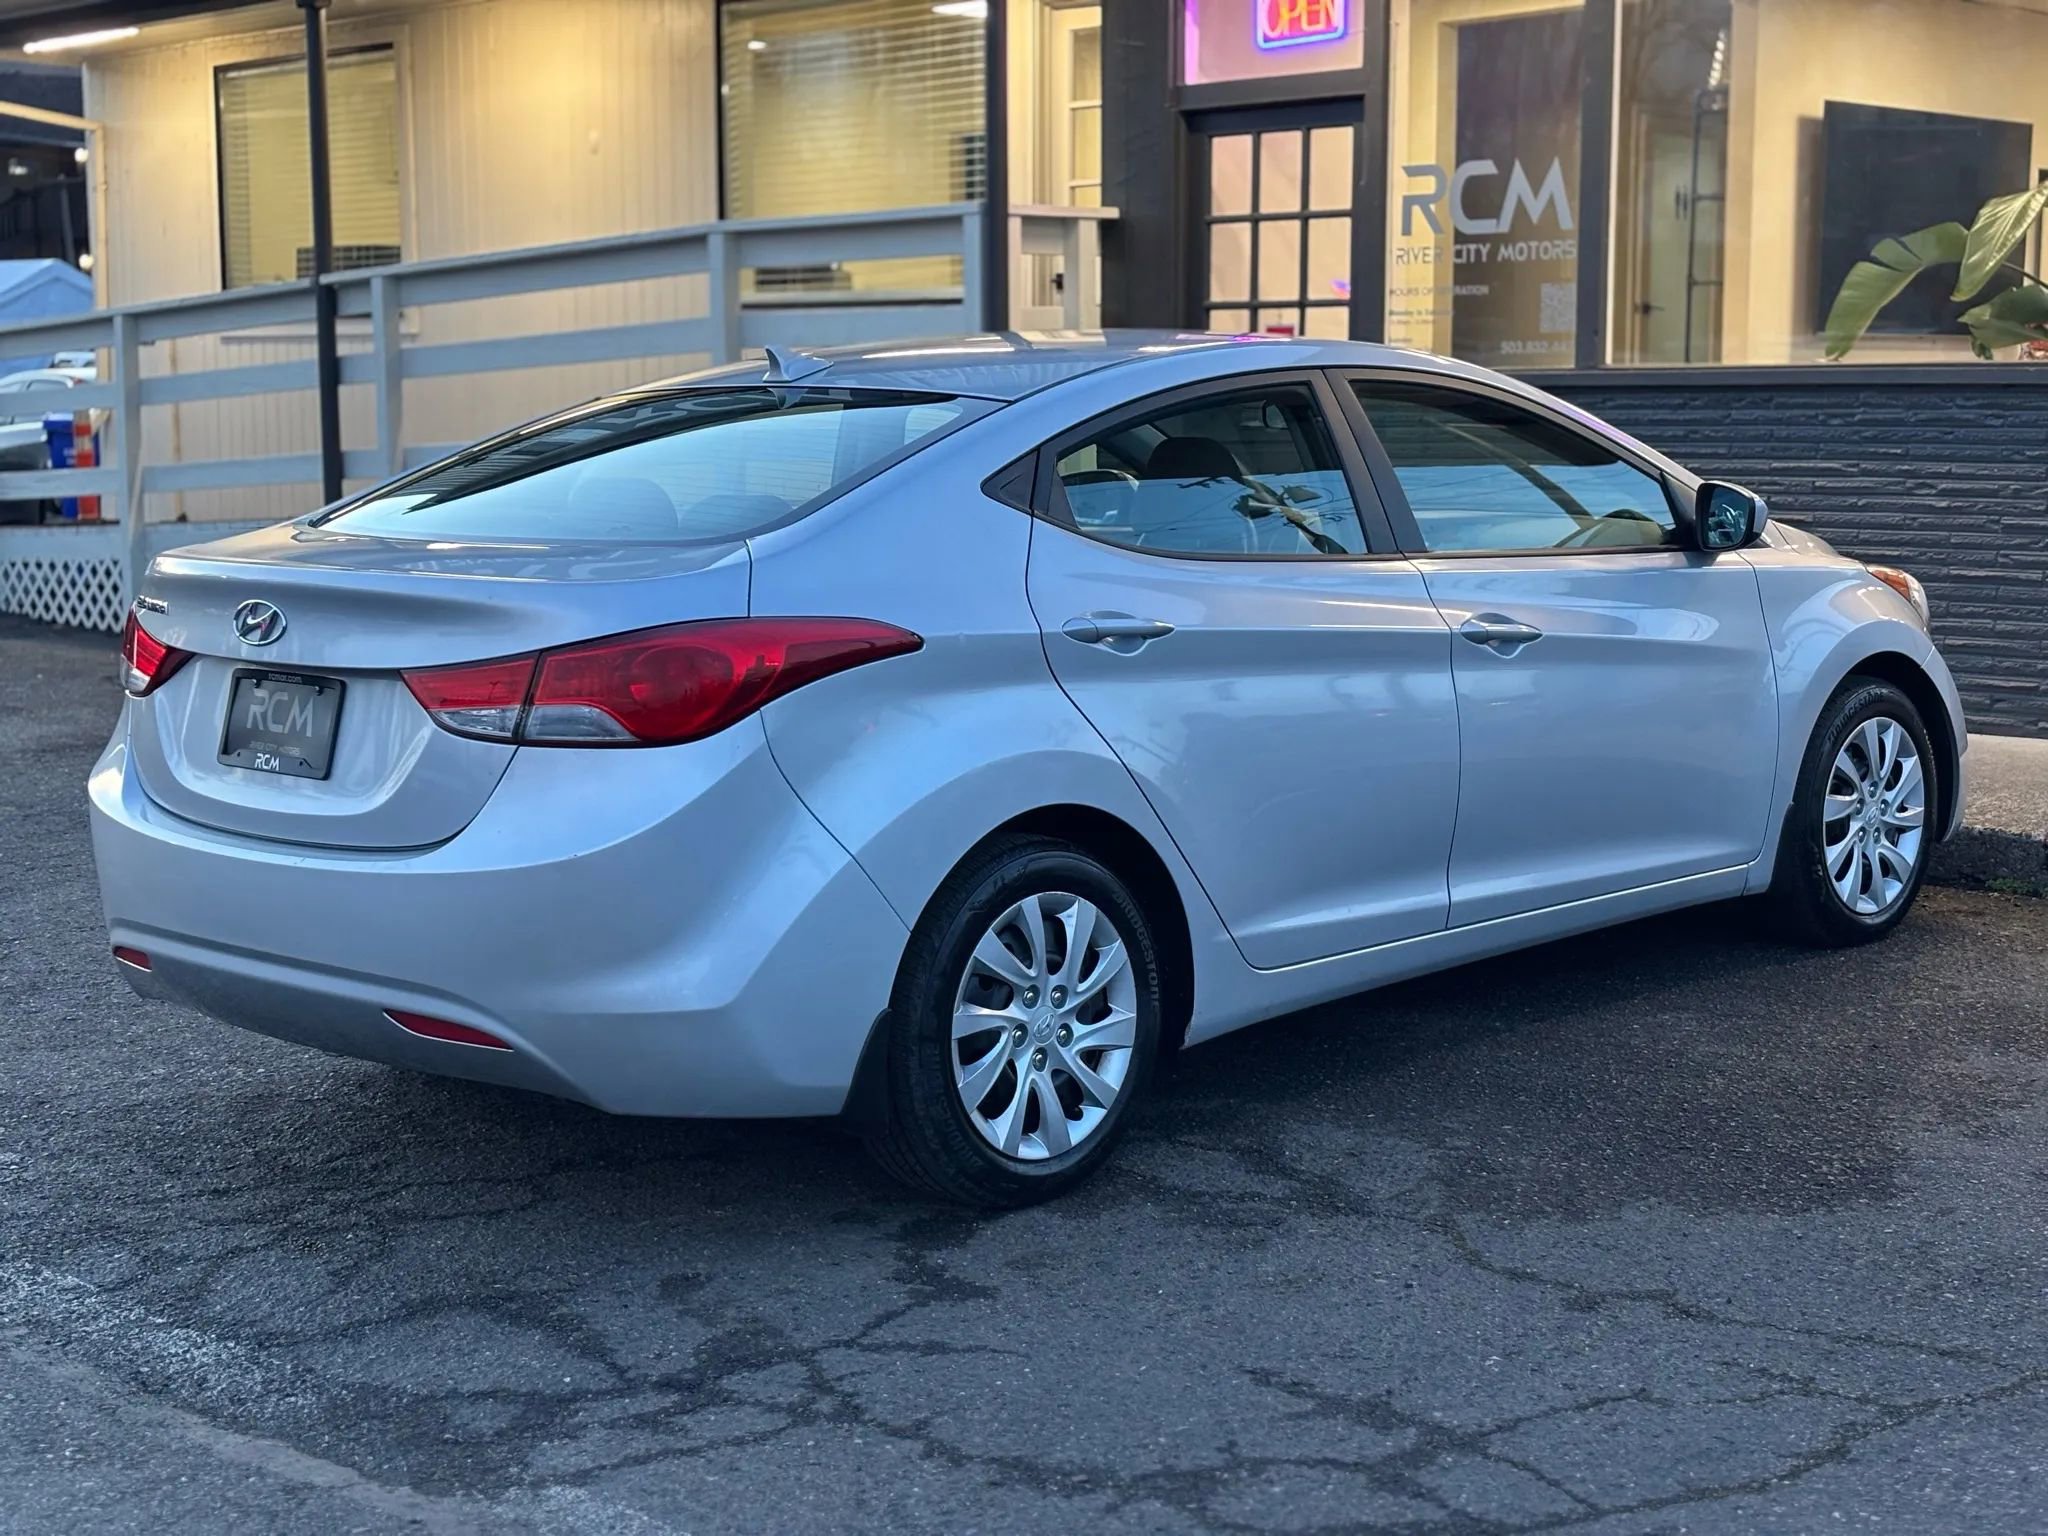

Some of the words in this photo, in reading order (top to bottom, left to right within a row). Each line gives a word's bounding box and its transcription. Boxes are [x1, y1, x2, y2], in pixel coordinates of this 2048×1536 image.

[1260, 0, 1340, 38] OPEN
[1401, 156, 1574, 236] RCM
[1396, 246, 1443, 265] RIVER
[1453, 243, 1490, 264] CITY
[1497, 239, 1577, 262] MOTORS
[246, 688, 314, 738] RCM
[254, 752, 280, 771] RCM
